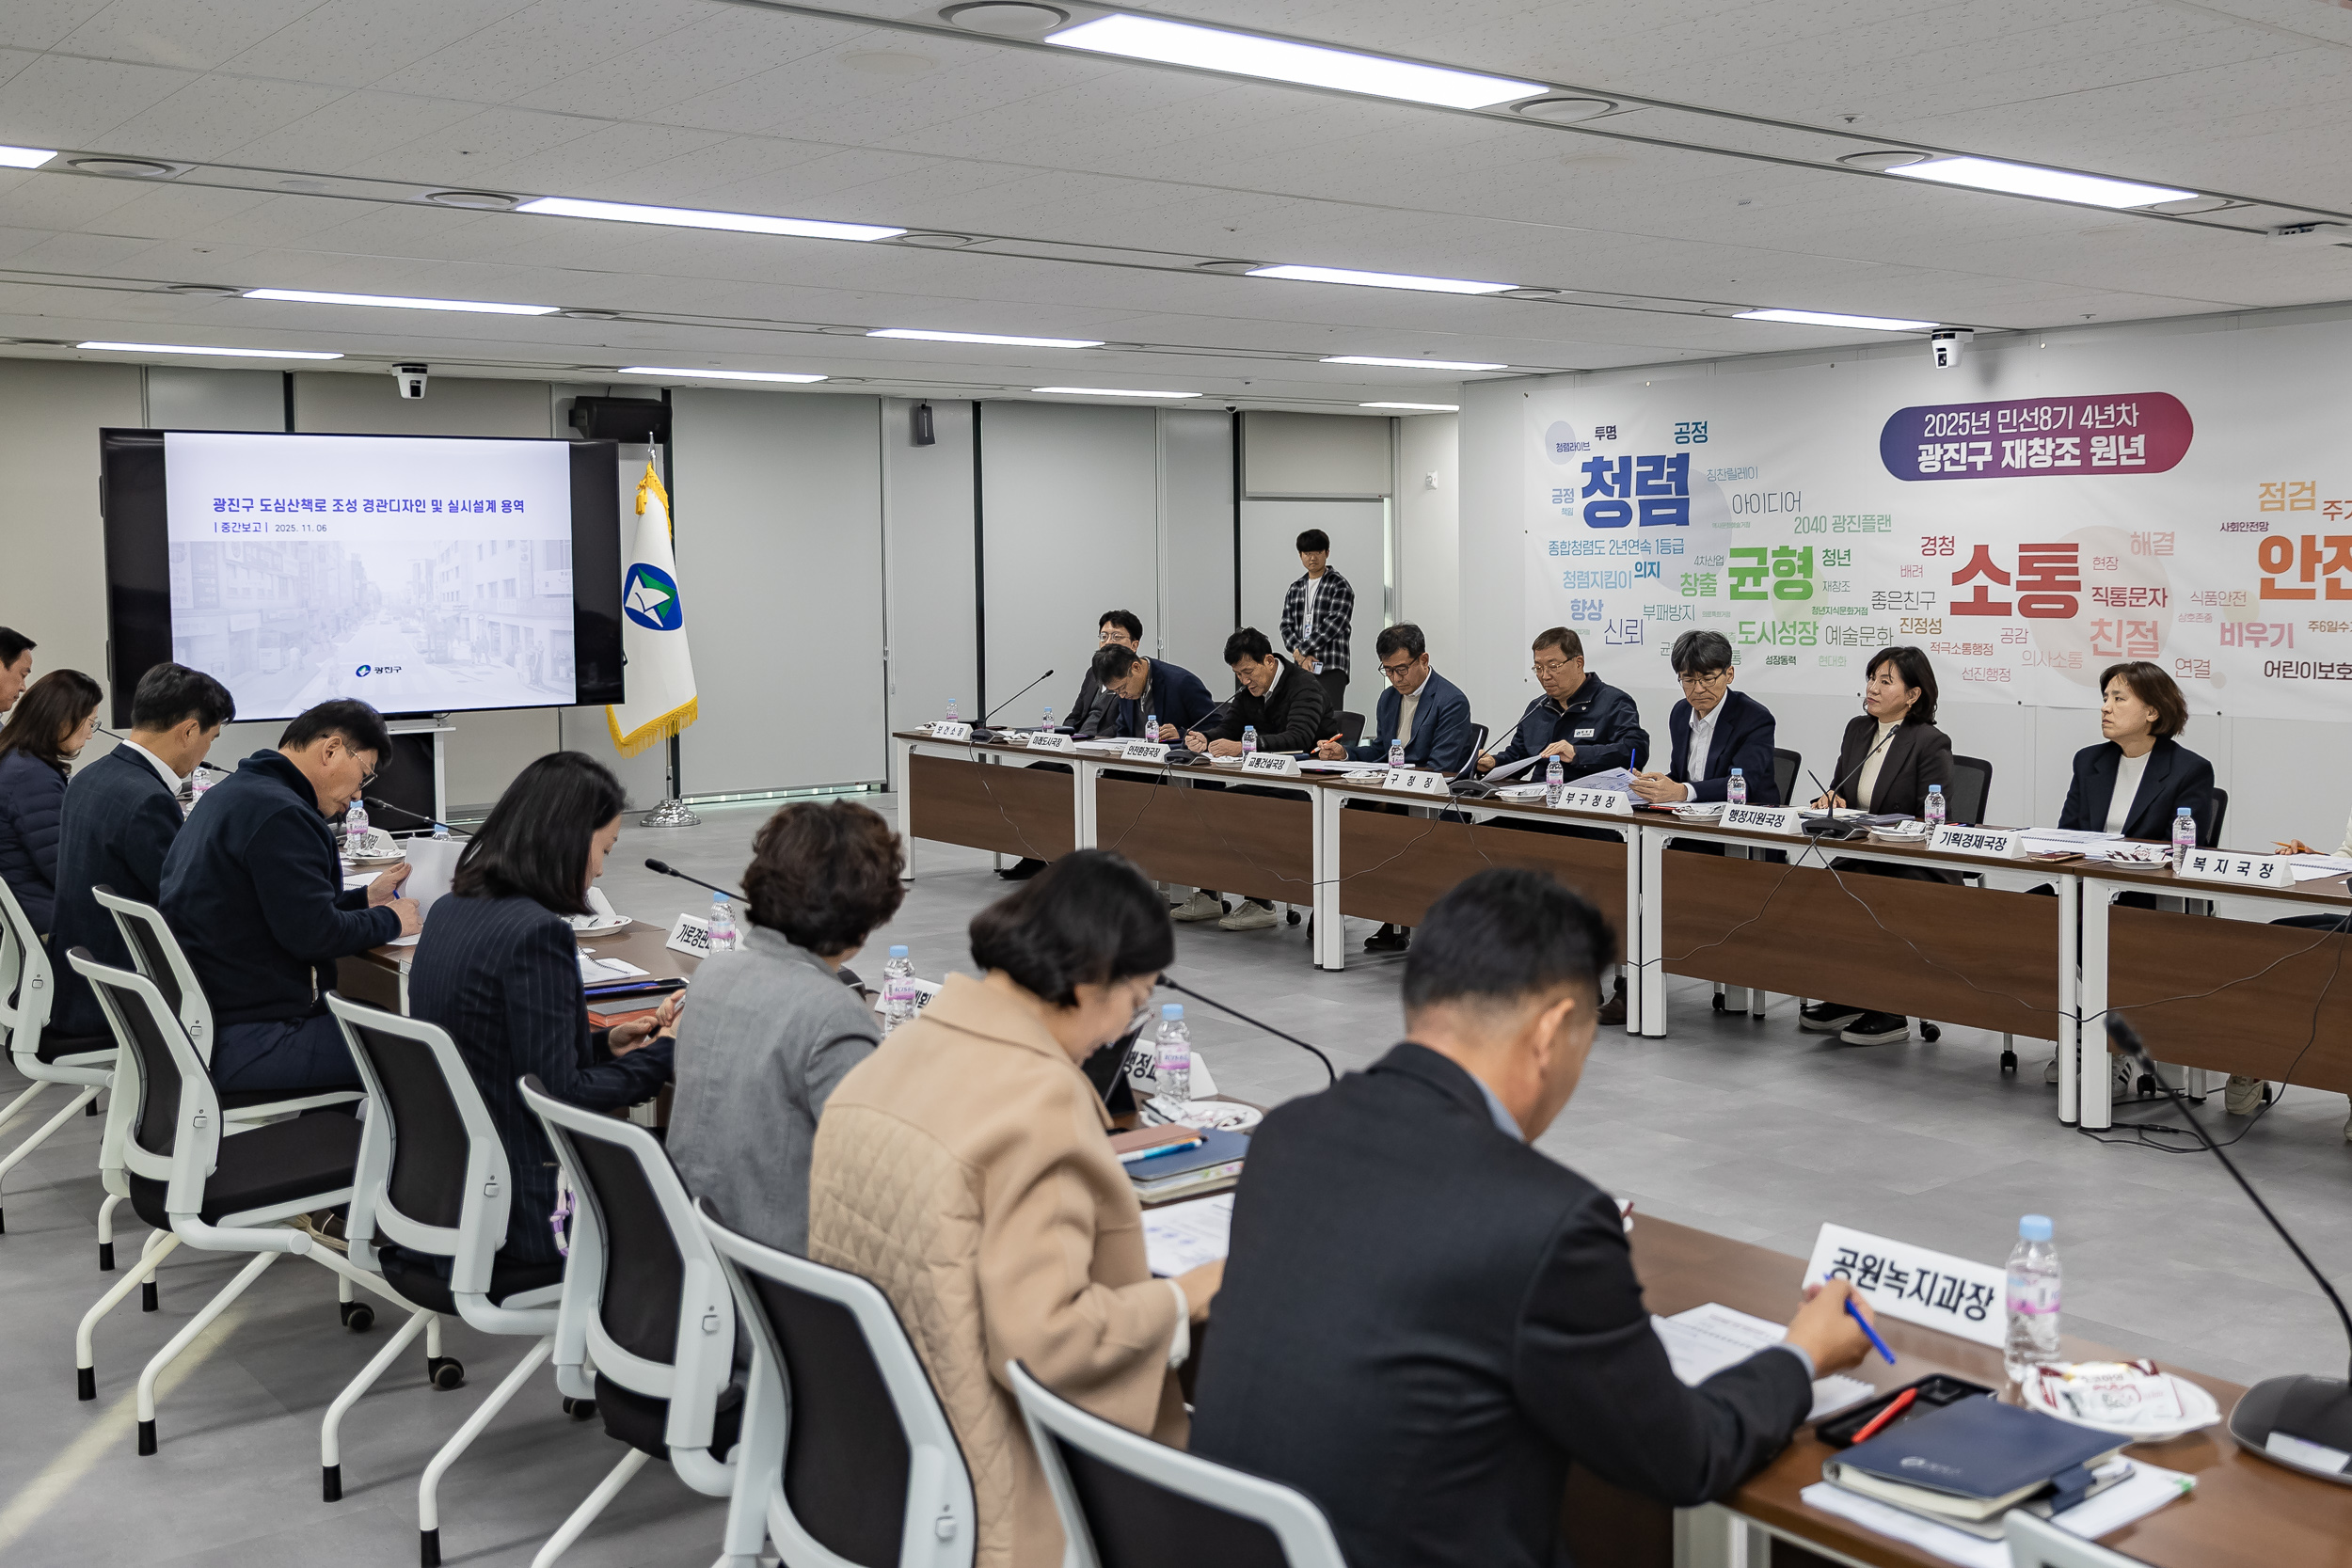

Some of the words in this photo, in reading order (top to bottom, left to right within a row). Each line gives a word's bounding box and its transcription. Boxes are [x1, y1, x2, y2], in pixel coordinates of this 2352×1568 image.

[1924, 410, 1991, 437] 2025년
[1996, 405, 2074, 435] 민선8기
[2079, 403, 2139, 430] 4년차
[1595, 425, 1617, 441] 투명
[1674, 420, 1708, 445] 공정
[1556, 441, 1591, 453] 청렴라이브
[1917, 440, 1993, 473] 광진구
[2001, 436, 2082, 469] 재창조
[2090, 434, 2146, 467] 원년
[1707, 467, 1758, 483] 칭찬릴레이
[1552, 488, 1574, 504] 긍정
[1581, 452, 1690, 529] 청렴
[2259, 481, 2316, 513] 점검
[213, 498, 254, 513] 광진구
[260, 498, 326, 513] 도심산책로
[332, 499, 357, 513] 조성
[362, 499, 426, 513] 경관디자인
[431, 499, 443, 513] 및
[448, 499, 497, 513] 실시설계
[501, 499, 524, 514] 용역
[1732, 491, 1802, 515] 아이디어
[221, 522, 262, 533] 중간보고
[275, 524, 298, 532] 2025.
[302, 524, 314, 532] 11.
[316, 524, 327, 532] 06
[1794, 515, 1827, 534] 2040
[1832, 514, 1892, 533] 광진플랜
[2219, 521, 2269, 532] 사회안전망
[1549, 540, 1606, 556] 종합청렴도
[1609, 539, 1652, 556] 2년연속
[1655, 538, 1685, 555] 1등급
[1921, 535, 1955, 557] 경청
[2130, 531, 2175, 556] 해결
[1694, 555, 1724, 567] 4차산업
[1821, 548, 1851, 567] 청년
[2092, 556, 2119, 571] 현장
[1634, 561, 1661, 578] 의지
[1727, 546, 1814, 601] 균형
[1899, 564, 1924, 578] 배려
[1563, 570, 1632, 590] 청렴지킴이
[1680, 572, 1718, 597] 창출
[1821, 580, 1851, 593] 재창조
[1949, 543, 2082, 619] 소통
[1871, 590, 1936, 611] 좋은친구
[2091, 586, 2169, 608] 직통문자
[2190, 590, 2247, 607] 식품안전
[1570, 598, 1604, 622] 향상
[1643, 604, 1695, 622] 부패방지
[1604, 618, 1644, 646] 신뢰
[1738, 620, 1819, 646] 도시성장
[1899, 617, 1943, 635] 진정성
[2000, 627, 2029, 644] 공감
[2219, 622, 2295, 649] 비우기
[2308, 621, 2352, 633] 주6일수
[1825, 626, 1894, 647] 예술문화
[2090, 618, 2160, 658] 친절
[1931, 641, 1994, 657] 적극소통행정
[2022, 649, 2084, 669] 의사소통
[373, 666, 402, 674] 광진구
[1765, 655, 1797, 666] 성장동력
[1818, 655, 1847, 667] 현대화
[2175, 657, 2211, 679] 연결
[1962, 666, 2011, 683] 선진행정
[1727, 808, 1786, 829] 행정지원국장
[1939, 831, 2008, 851] 기획경제국장
[1830, 1246, 1995, 1322] 공원녹지과장
